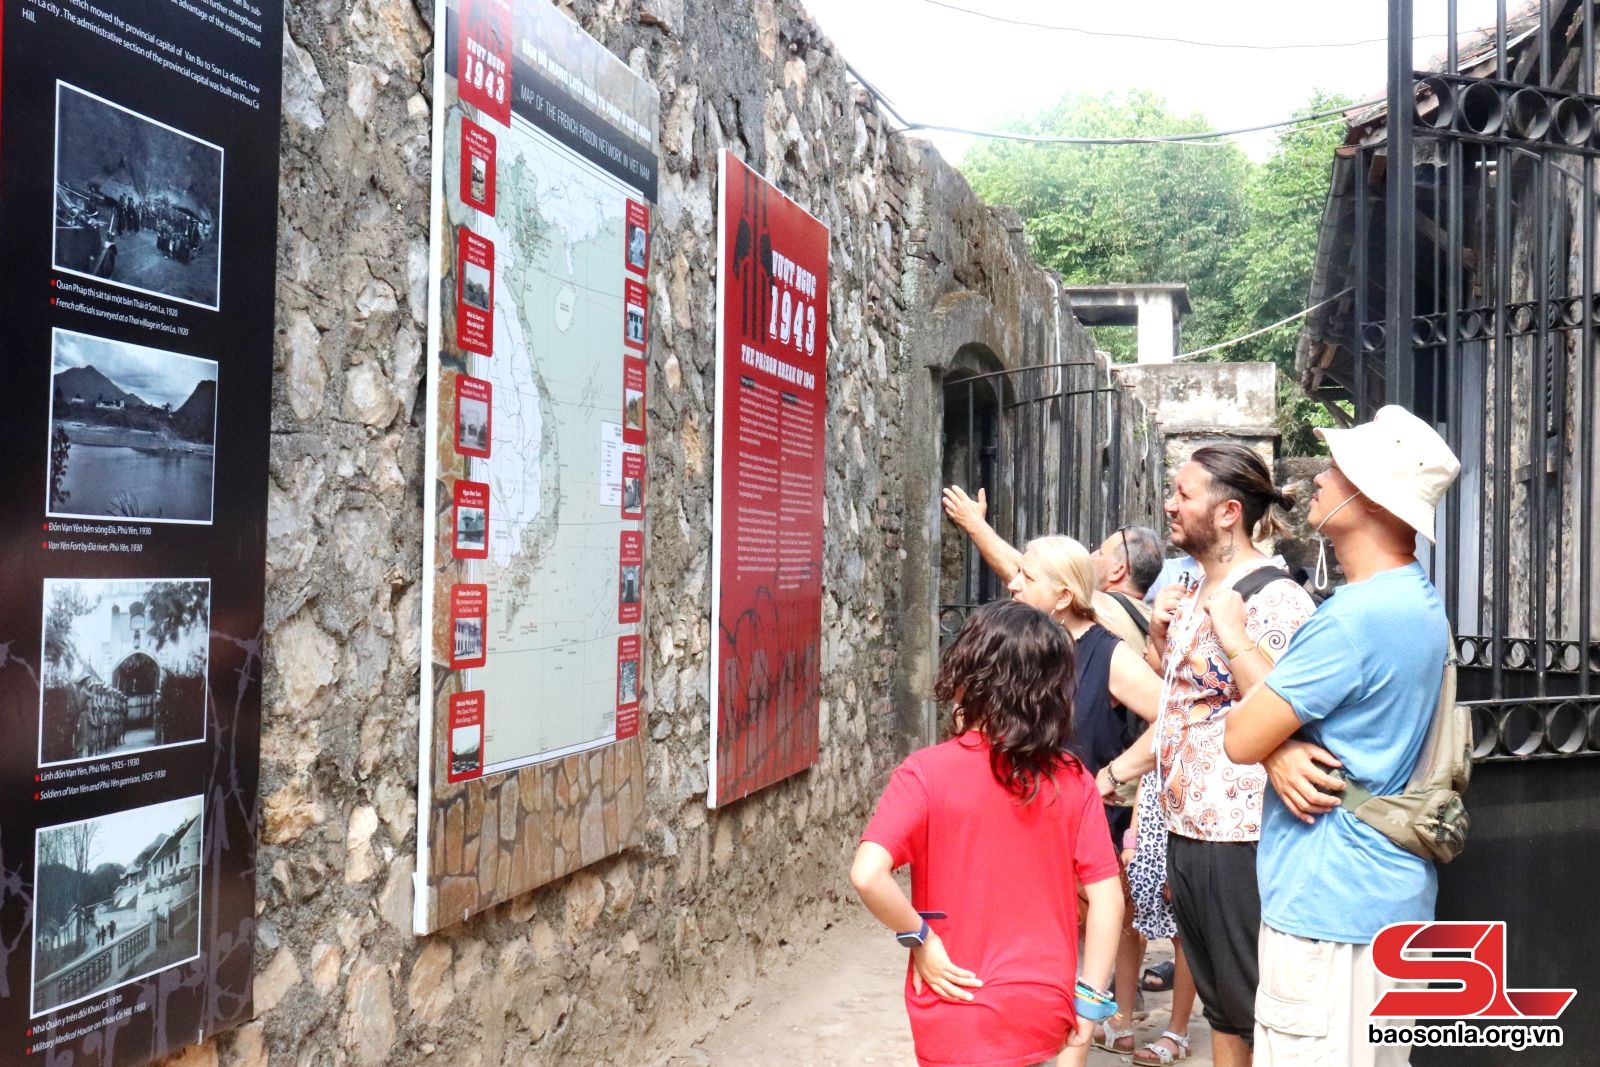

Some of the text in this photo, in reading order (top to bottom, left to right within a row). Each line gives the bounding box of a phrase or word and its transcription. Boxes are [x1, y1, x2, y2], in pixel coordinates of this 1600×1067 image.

[22, 8, 36, 23] Hill.
[179, 0, 261, 48] advantage of the existing native
[229, 10, 262, 32] strengthened
[47, 3, 60, 17] city
[77, 18, 122, 45] administrative
[123, 40, 145, 56] section
[146, 50, 153, 60] of
[153, 53, 162, 64] the
[163, 60, 191, 77] provincial
[191, 71, 208, 86] capital
[209, 81, 219, 91] was
[220, 84, 231, 97] built
[232, 91, 239, 100] on
[240, 92, 252, 106] Khau
[253, 99, 260, 110] Ca
[90, 6, 113, 24] moved
[114, 16, 125, 29] the
[126, 24, 155, 43] provincial
[156, 38, 176, 54] capital
[176, 48, 183, 57] of
[185, 51, 195, 64] Van
[197, 56, 204, 68] Bu
[204, 60, 211, 71] to
[212, 64, 222, 76] Son
[223, 69, 229, 79] La
[230, 73, 248, 90] district,
[249, 84, 260, 94] now
[465, 54, 505, 104] 1943
[521, 84, 534, 104] MAP
[536, 94, 544, 111] OF
[546, 100, 556, 122] THE
[558, 109, 578, 136] FRENCH
[580, 123, 598, 149] PRISON
[599, 137, 622, 165] NETWORK
[622, 152, 629, 168] IN
[640, 163, 650, 181] NAM
[56, 298, 75, 310] French
[75, 303, 96, 314] officials
[96, 309, 119, 320] surveyed
[140, 318, 155, 330] village
[161, 323, 169, 332] Son
[178, 327, 188, 336] 1920
[166, 307, 178, 317] 1920
[769, 284, 816, 357] 1943
[741, 343, 755, 367] THE
[797, 368, 803, 387] OF
[70, 542, 81, 551] Fort
[81, 542, 88, 552] by
[130, 544, 142, 552] 1930
[139, 527, 151, 535] 1930
[88, 1004, 101, 1015] Khau
[109, 994, 122, 1006] 1930
[32, 1039, 54, 1053] Military
[55, 1030, 76, 1044] Medical
[77, 1024, 94, 1037] House
[94, 1021, 101, 1030] on
[102, 1015, 115, 1026] Khau
